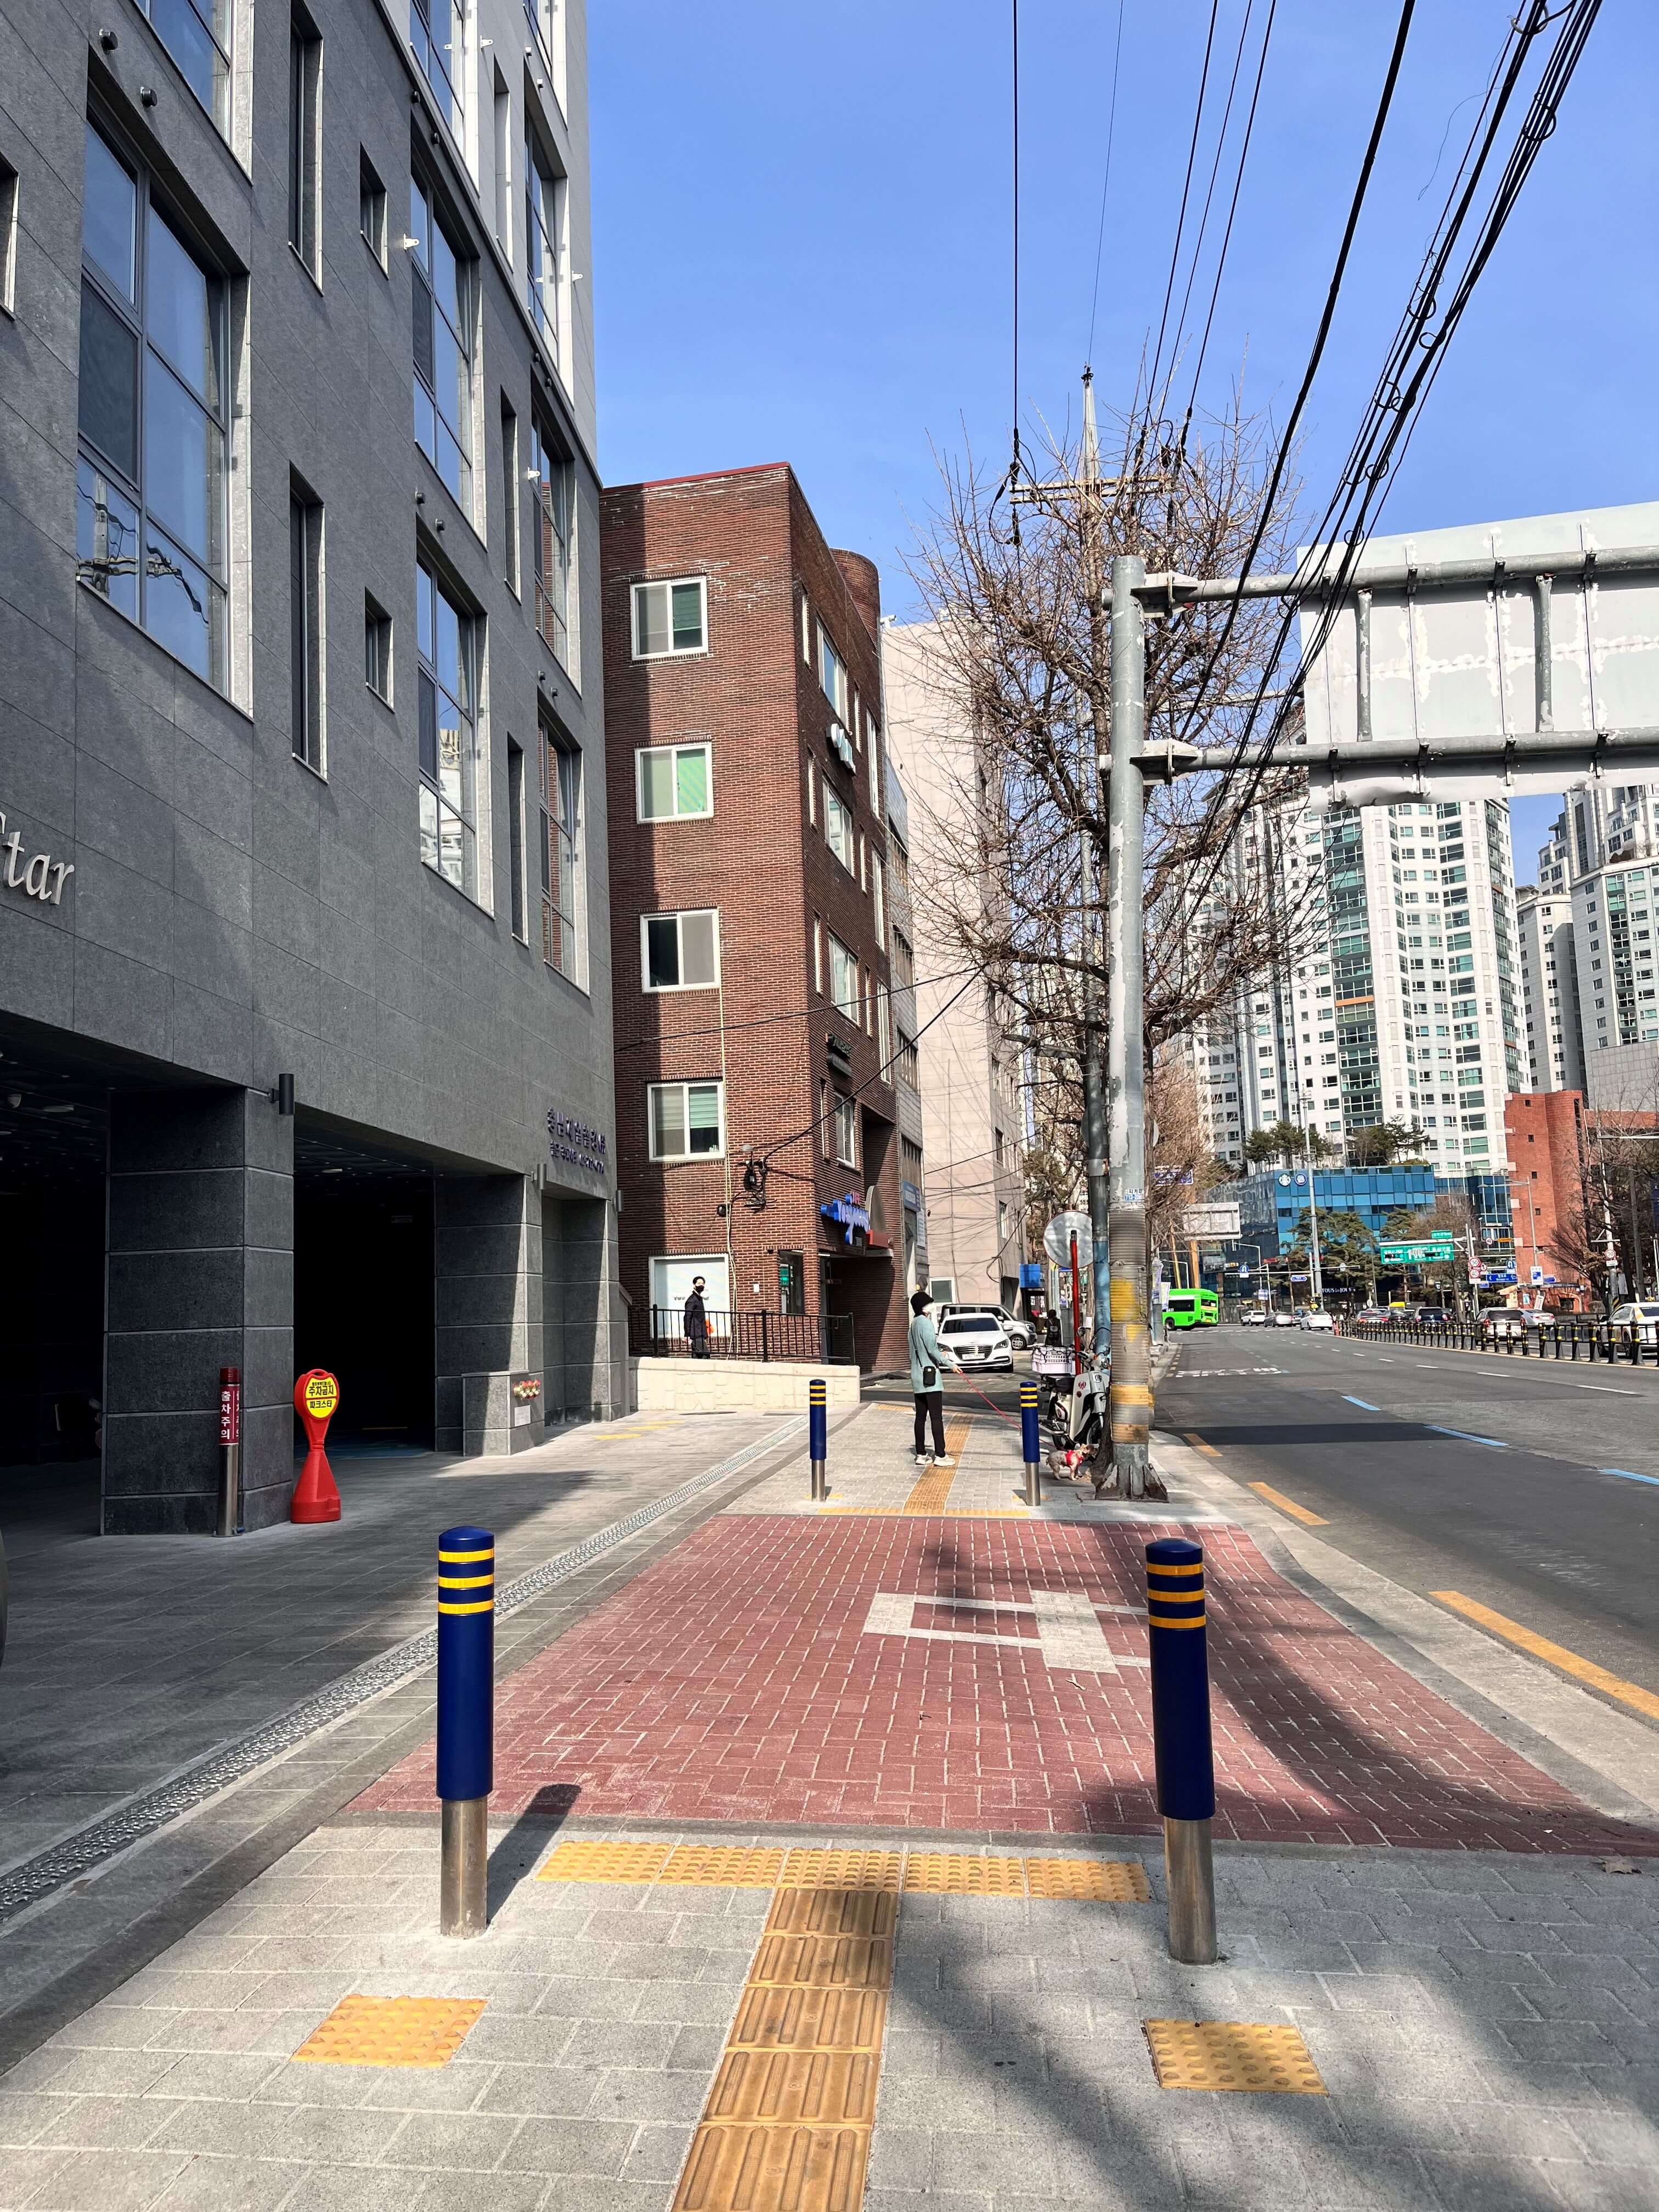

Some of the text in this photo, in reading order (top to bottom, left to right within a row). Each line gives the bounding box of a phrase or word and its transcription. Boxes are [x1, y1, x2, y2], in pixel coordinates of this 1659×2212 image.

[0, 812, 75, 905] tar
[309, 1385, 334, 1396] 주차금지
[310, 1400, 332, 1409] 파크스타
[221, 1391, 231, 1440] 출차주의
